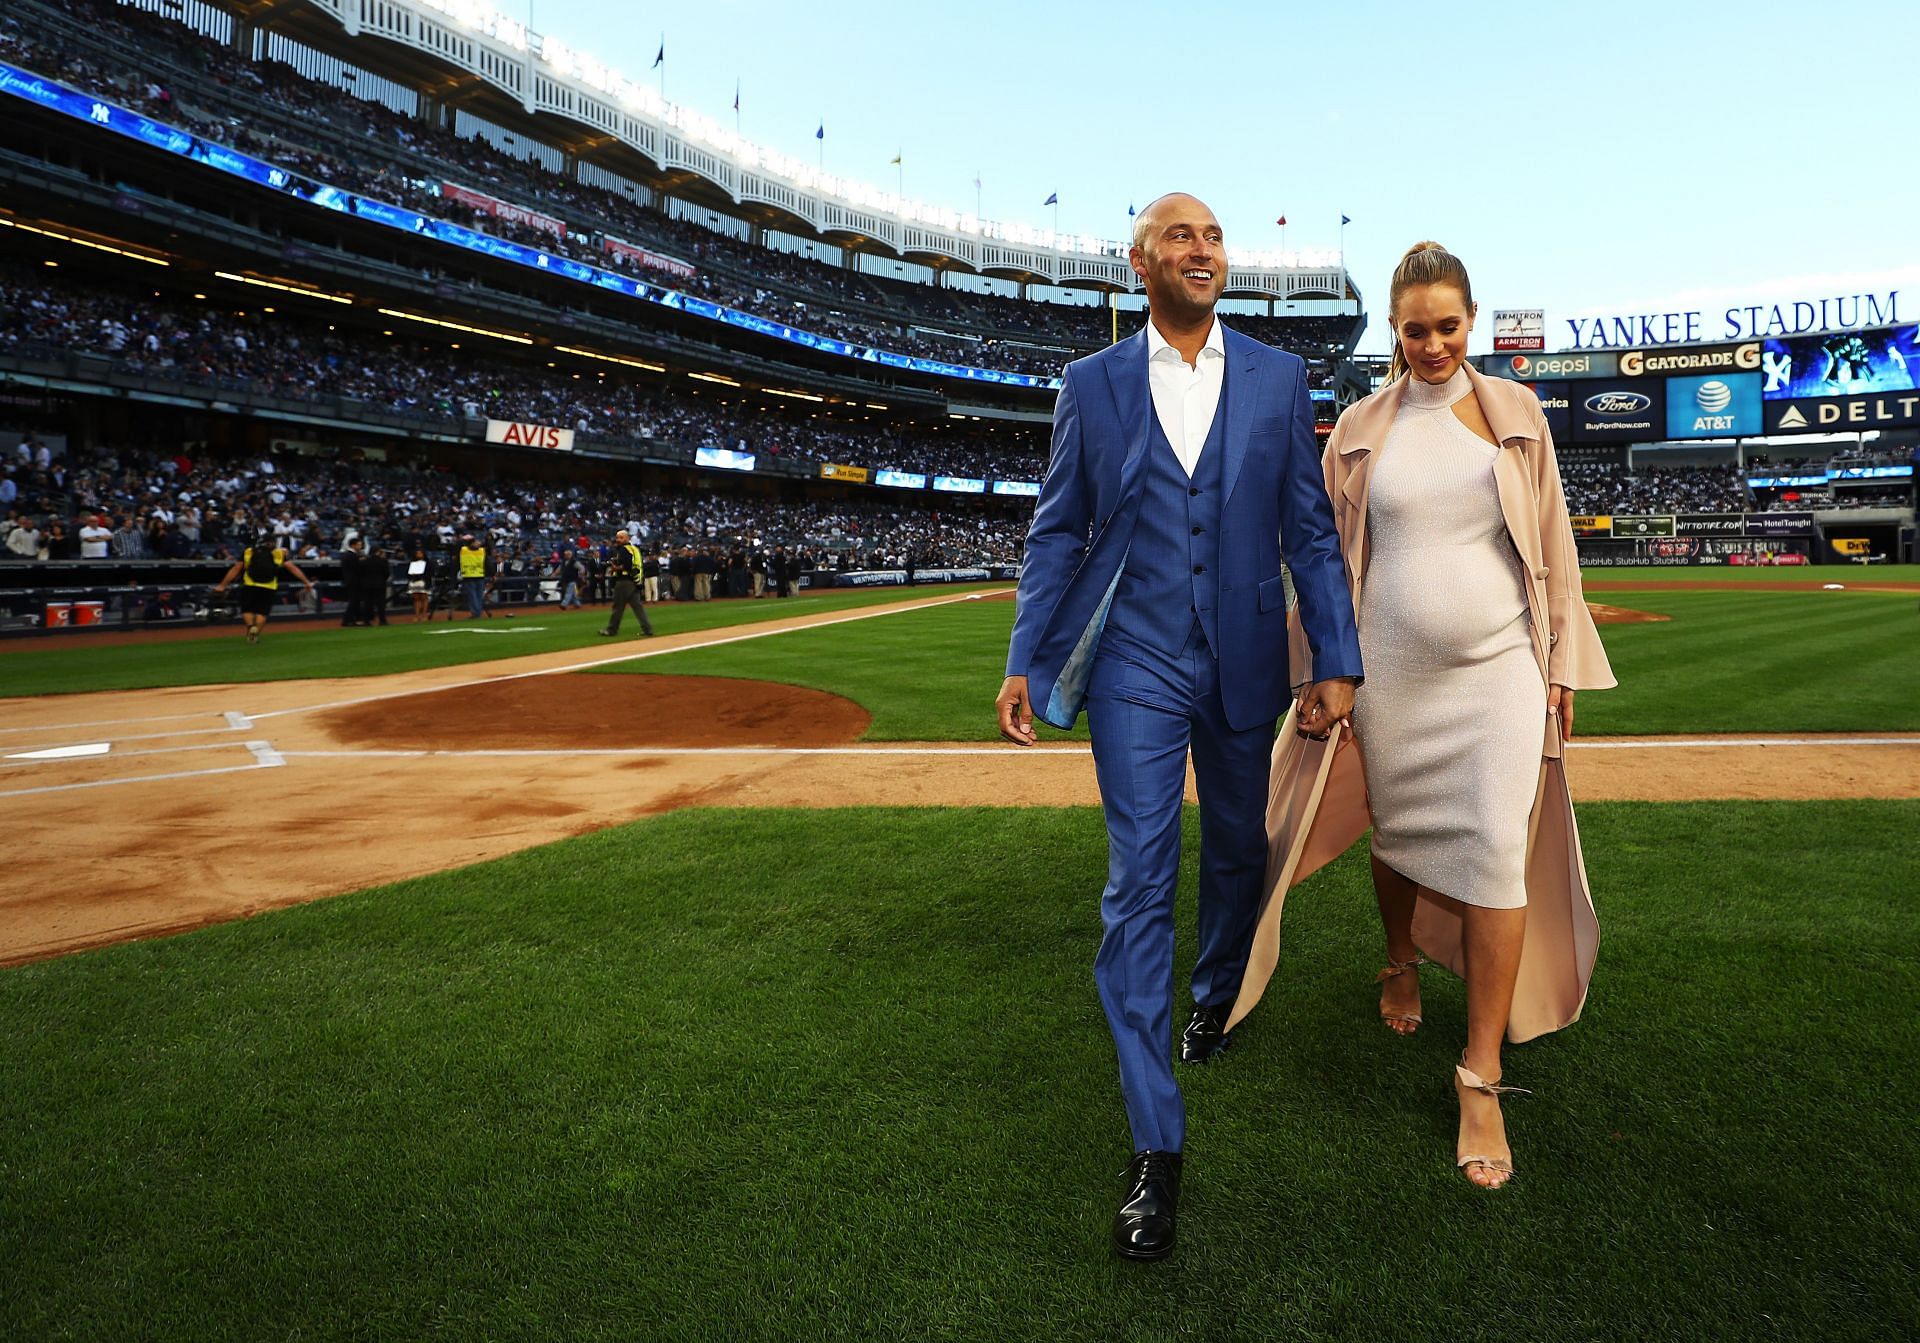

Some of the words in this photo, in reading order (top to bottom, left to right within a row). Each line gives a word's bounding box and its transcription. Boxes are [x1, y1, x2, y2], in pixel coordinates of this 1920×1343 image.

[496, 202, 531, 226] PARTY
[643, 253, 669, 273] PARTY
[1495, 312, 1543, 320] ARMITRON
[1566, 312, 1701, 348] YANKEE
[1725, 291, 1899, 339] STADIUM
[1498, 337, 1541, 345] ARMITRON
[1536, 356, 1590, 377] pepsi
[1620, 352, 1644, 376] G
[1646, 352, 1733, 370] GATORADE
[1735, 343, 1761, 369] G
[1597, 394, 1638, 412] Ford
[1585, 421, 1650, 431] BuyFordNow.com
[1693, 415, 1735, 430] AT&T
[503, 422, 560, 449] AVIS
[1571, 518, 1597, 527] WALT
[1580, 557, 1613, 566] StubHub
[1616, 556, 1650, 566] StubHub
[1653, 556, 1689, 565] StubHub
